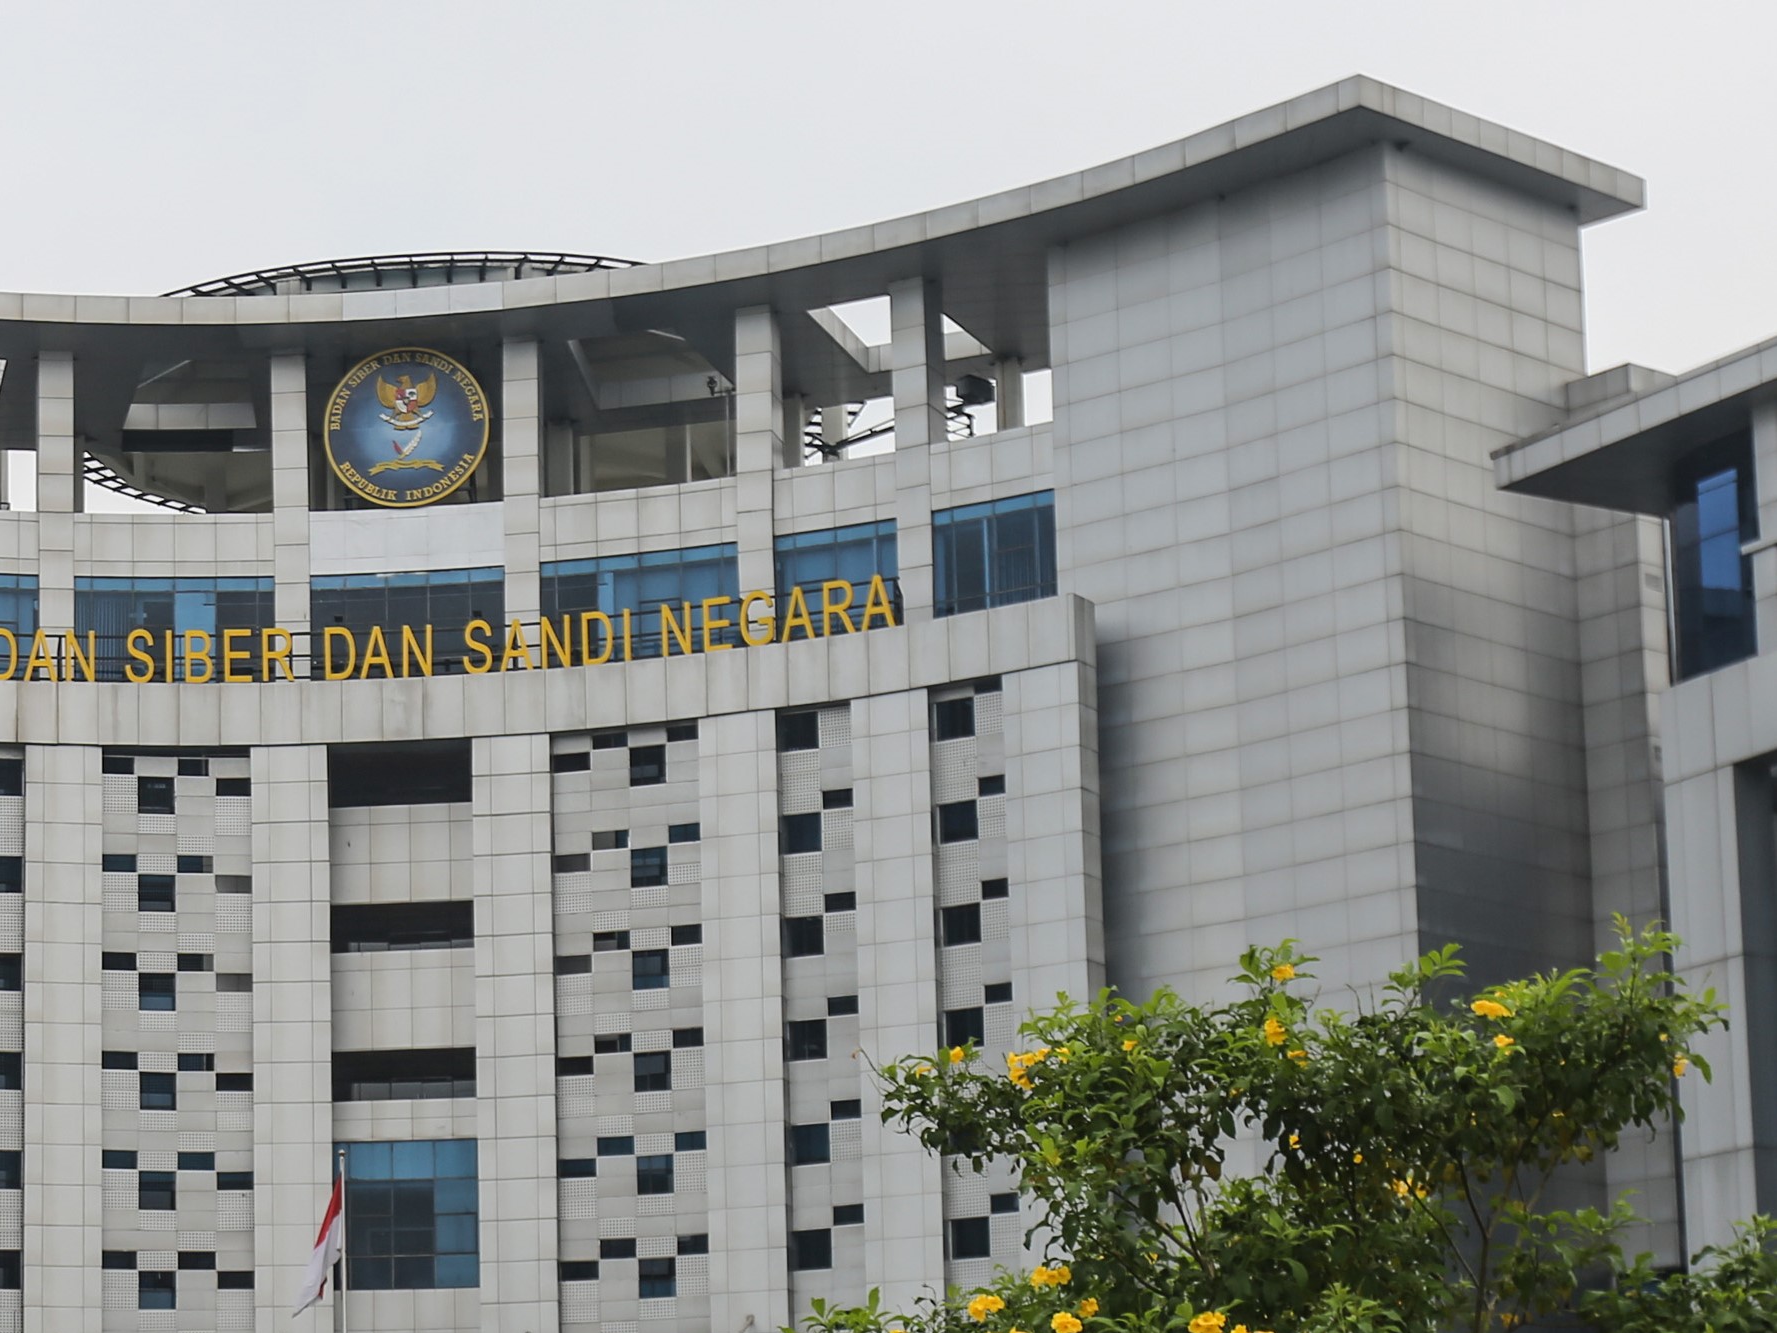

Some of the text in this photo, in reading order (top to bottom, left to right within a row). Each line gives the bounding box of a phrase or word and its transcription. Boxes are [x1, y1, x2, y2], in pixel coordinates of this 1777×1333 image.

[330, 352, 484, 431] BADAN SIBER DAN SANDI NEGARA
[339, 453, 475, 501] REPUBLIK INDONESIA
[125, 627, 295, 684] SIBER
[323, 624, 434, 681] DAN
[463, 608, 632, 675] SANDI
[661, 574, 898, 657] NEGARA
